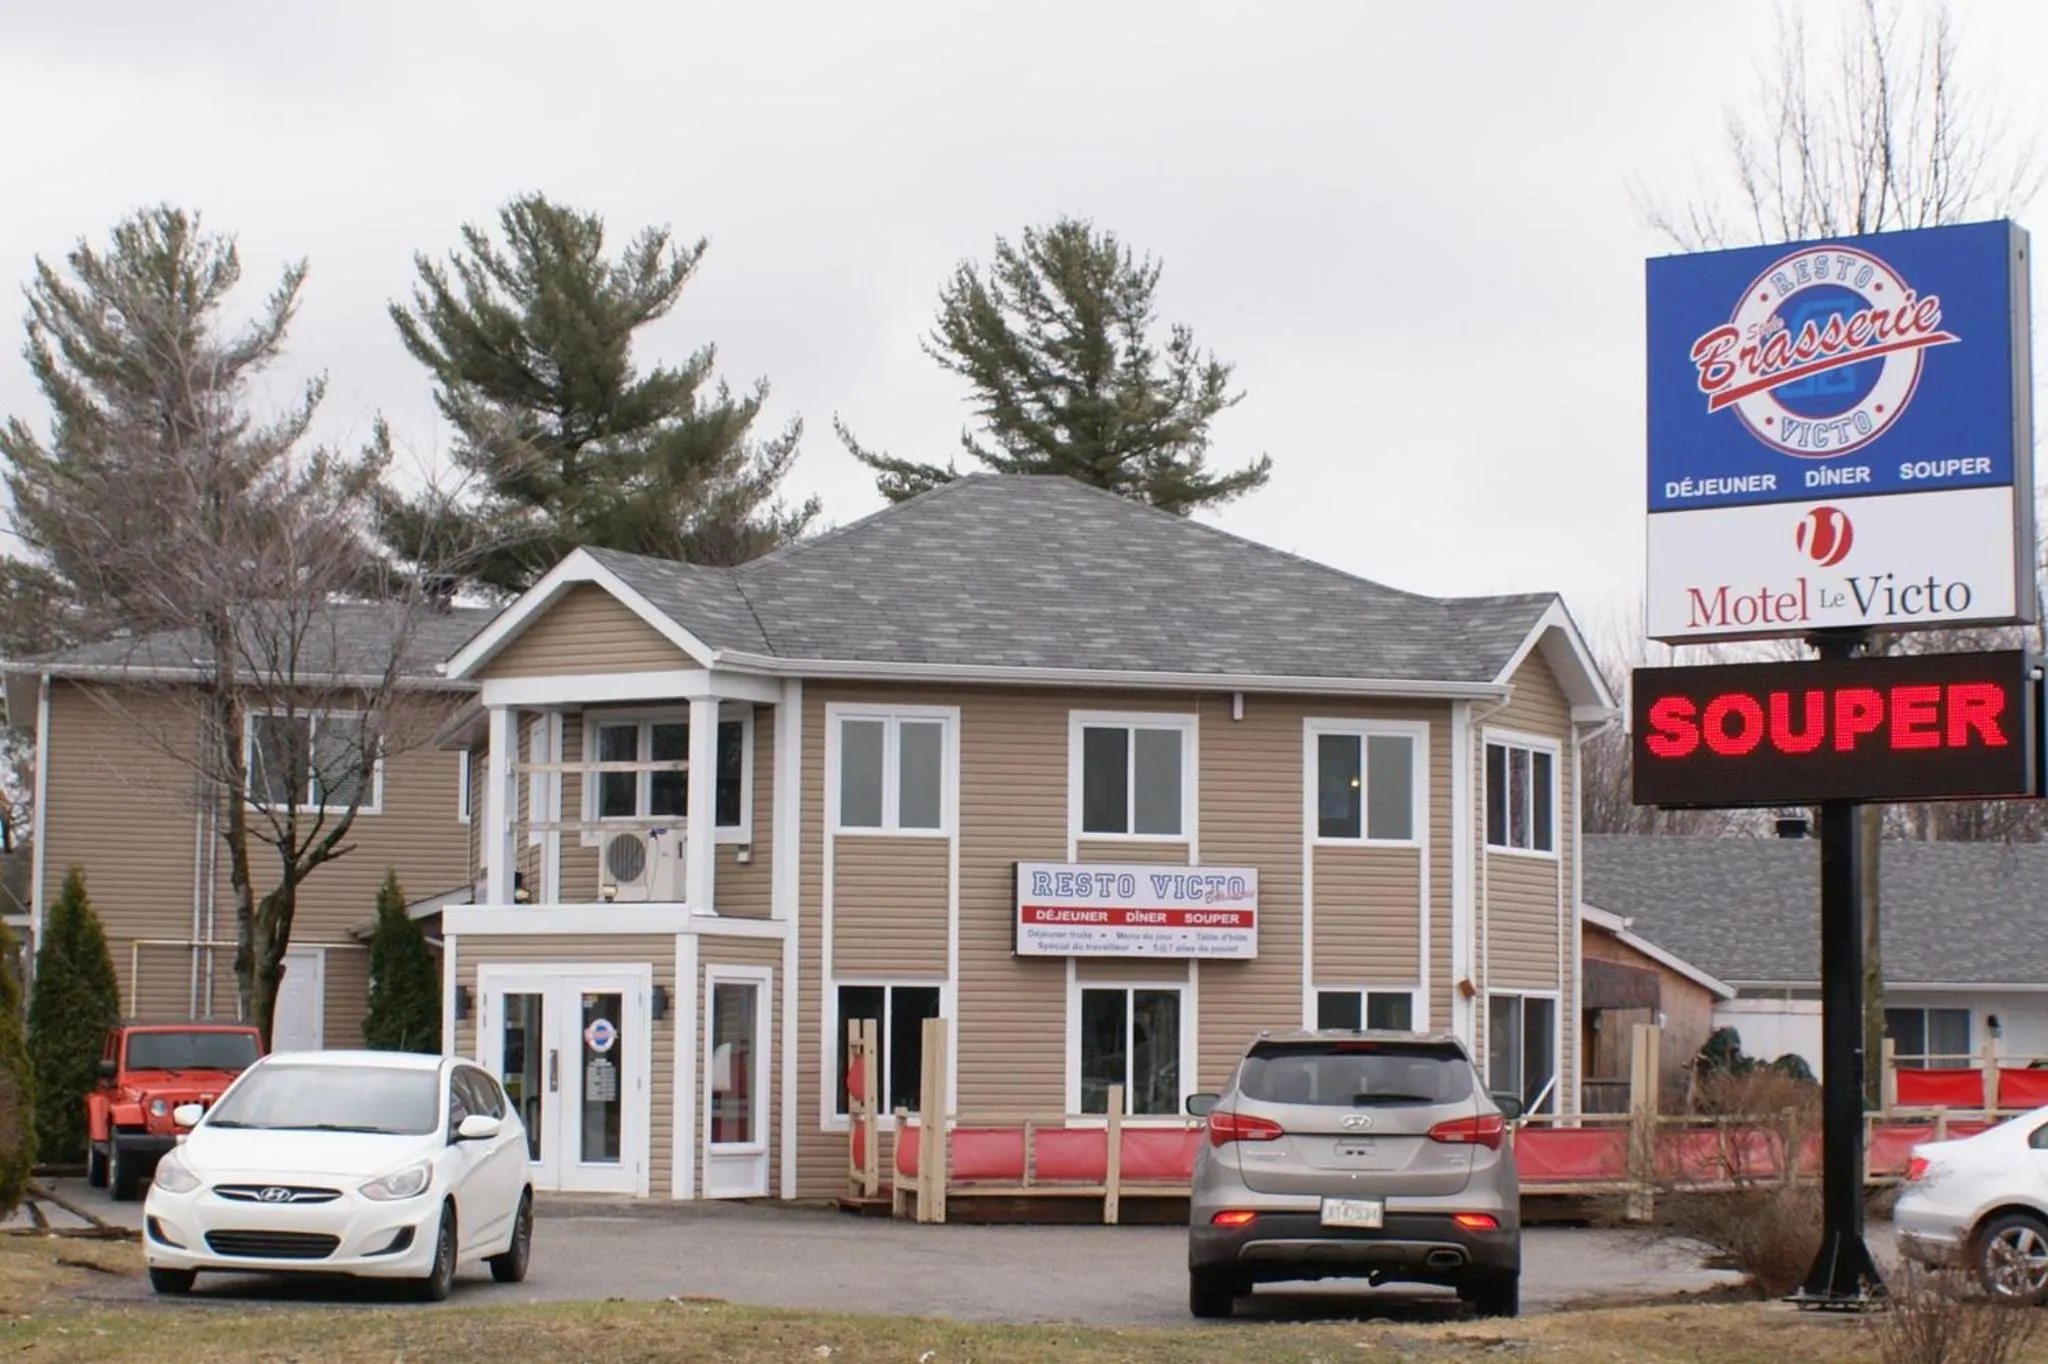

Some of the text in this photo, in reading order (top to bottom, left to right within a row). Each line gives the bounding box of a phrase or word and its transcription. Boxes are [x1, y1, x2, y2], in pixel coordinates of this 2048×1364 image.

[1769, 254, 1874, 297] RESTO
[1691, 290, 1941, 392] Brasserie
[1781, 410, 1873, 448] VICTO
[1665, 457, 1992, 499] DÉJEUNER DÎNER SOUPER
[1687, 573, 1972, 629] Motel Le Victo
[1645, 683, 2008, 758] SOUPER
[1032, 871, 1136, 898] RESTO
[1150, 874, 1246, 901] VICTO
[1035, 909, 1240, 925] DÉJEUNER DÎNER SOUPER
